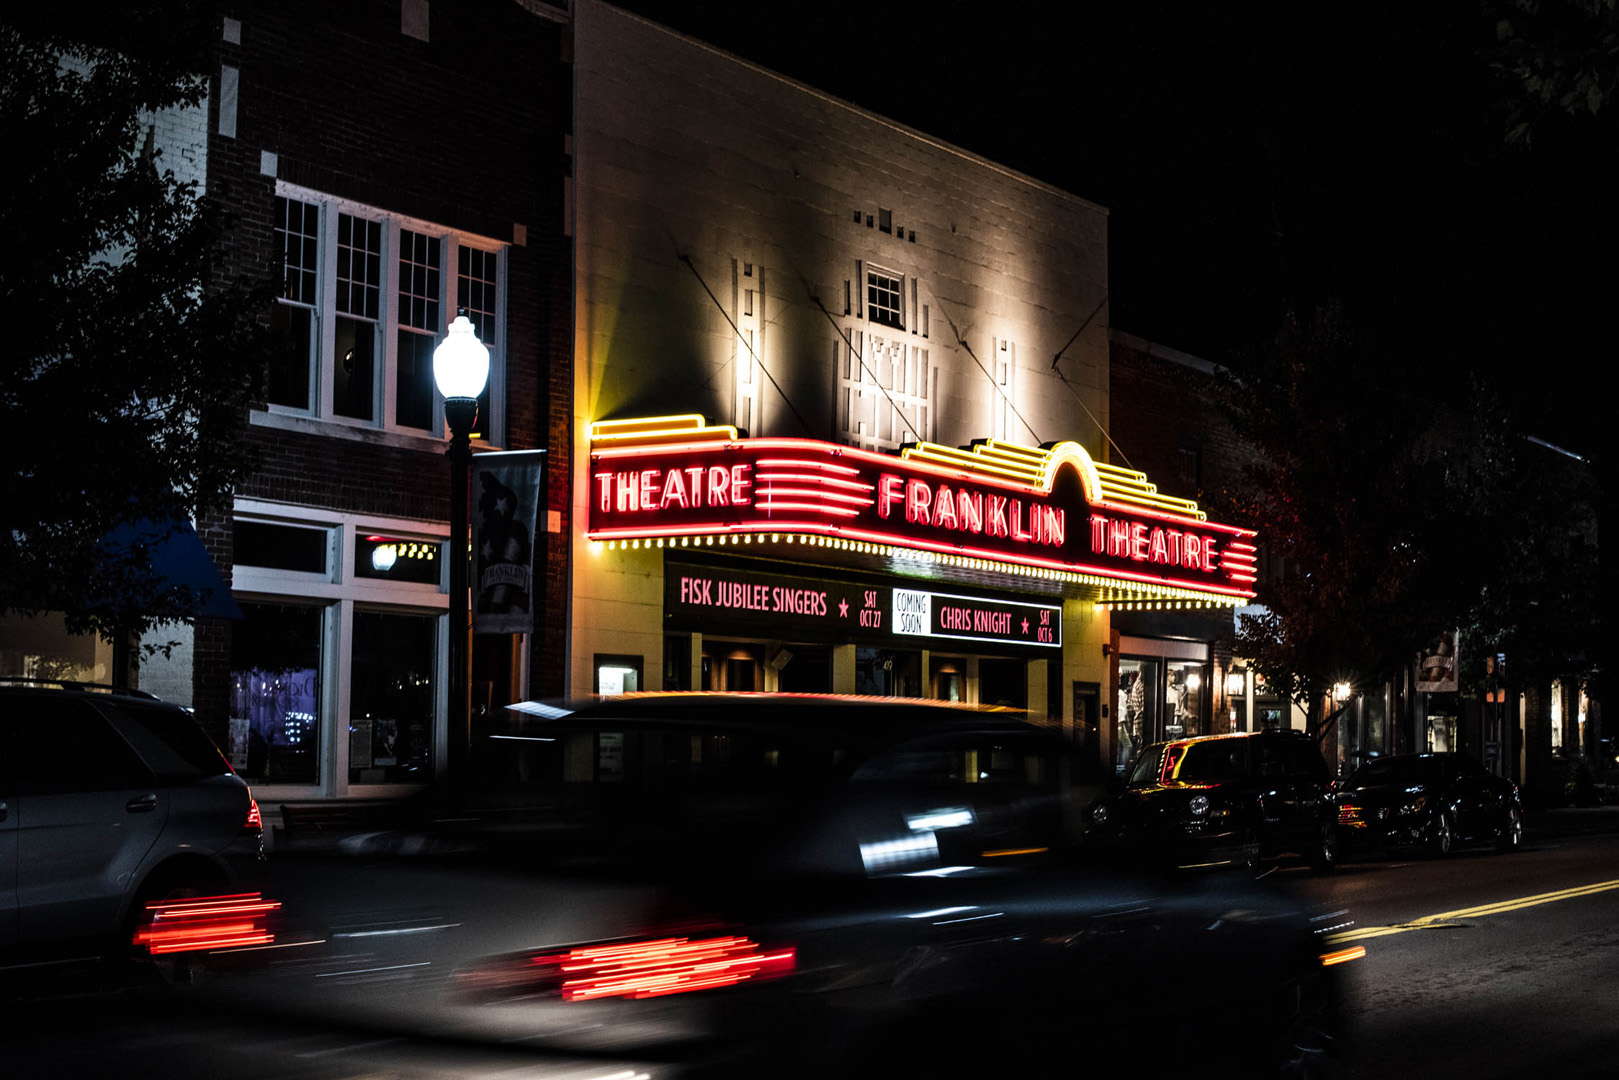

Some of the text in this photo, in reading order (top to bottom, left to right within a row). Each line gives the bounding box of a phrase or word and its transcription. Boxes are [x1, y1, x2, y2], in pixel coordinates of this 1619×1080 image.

[595, 464, 752, 513] THEATRE
[878, 472, 1220, 571] FRANKLIN THEATRE
[681, 577, 827, 617] FISK JUBILEE SINGERS
[864, 590, 877, 608] SAT
[896, 592, 926, 614] COMING
[859, 609, 881, 628] OCT 27
[900, 613, 922, 633] SOON
[940, 606, 1012, 635] CHRIS KNIGHT
[1040, 610, 1050, 625] SAT
[1037, 627, 1053, 643] OCT 6
